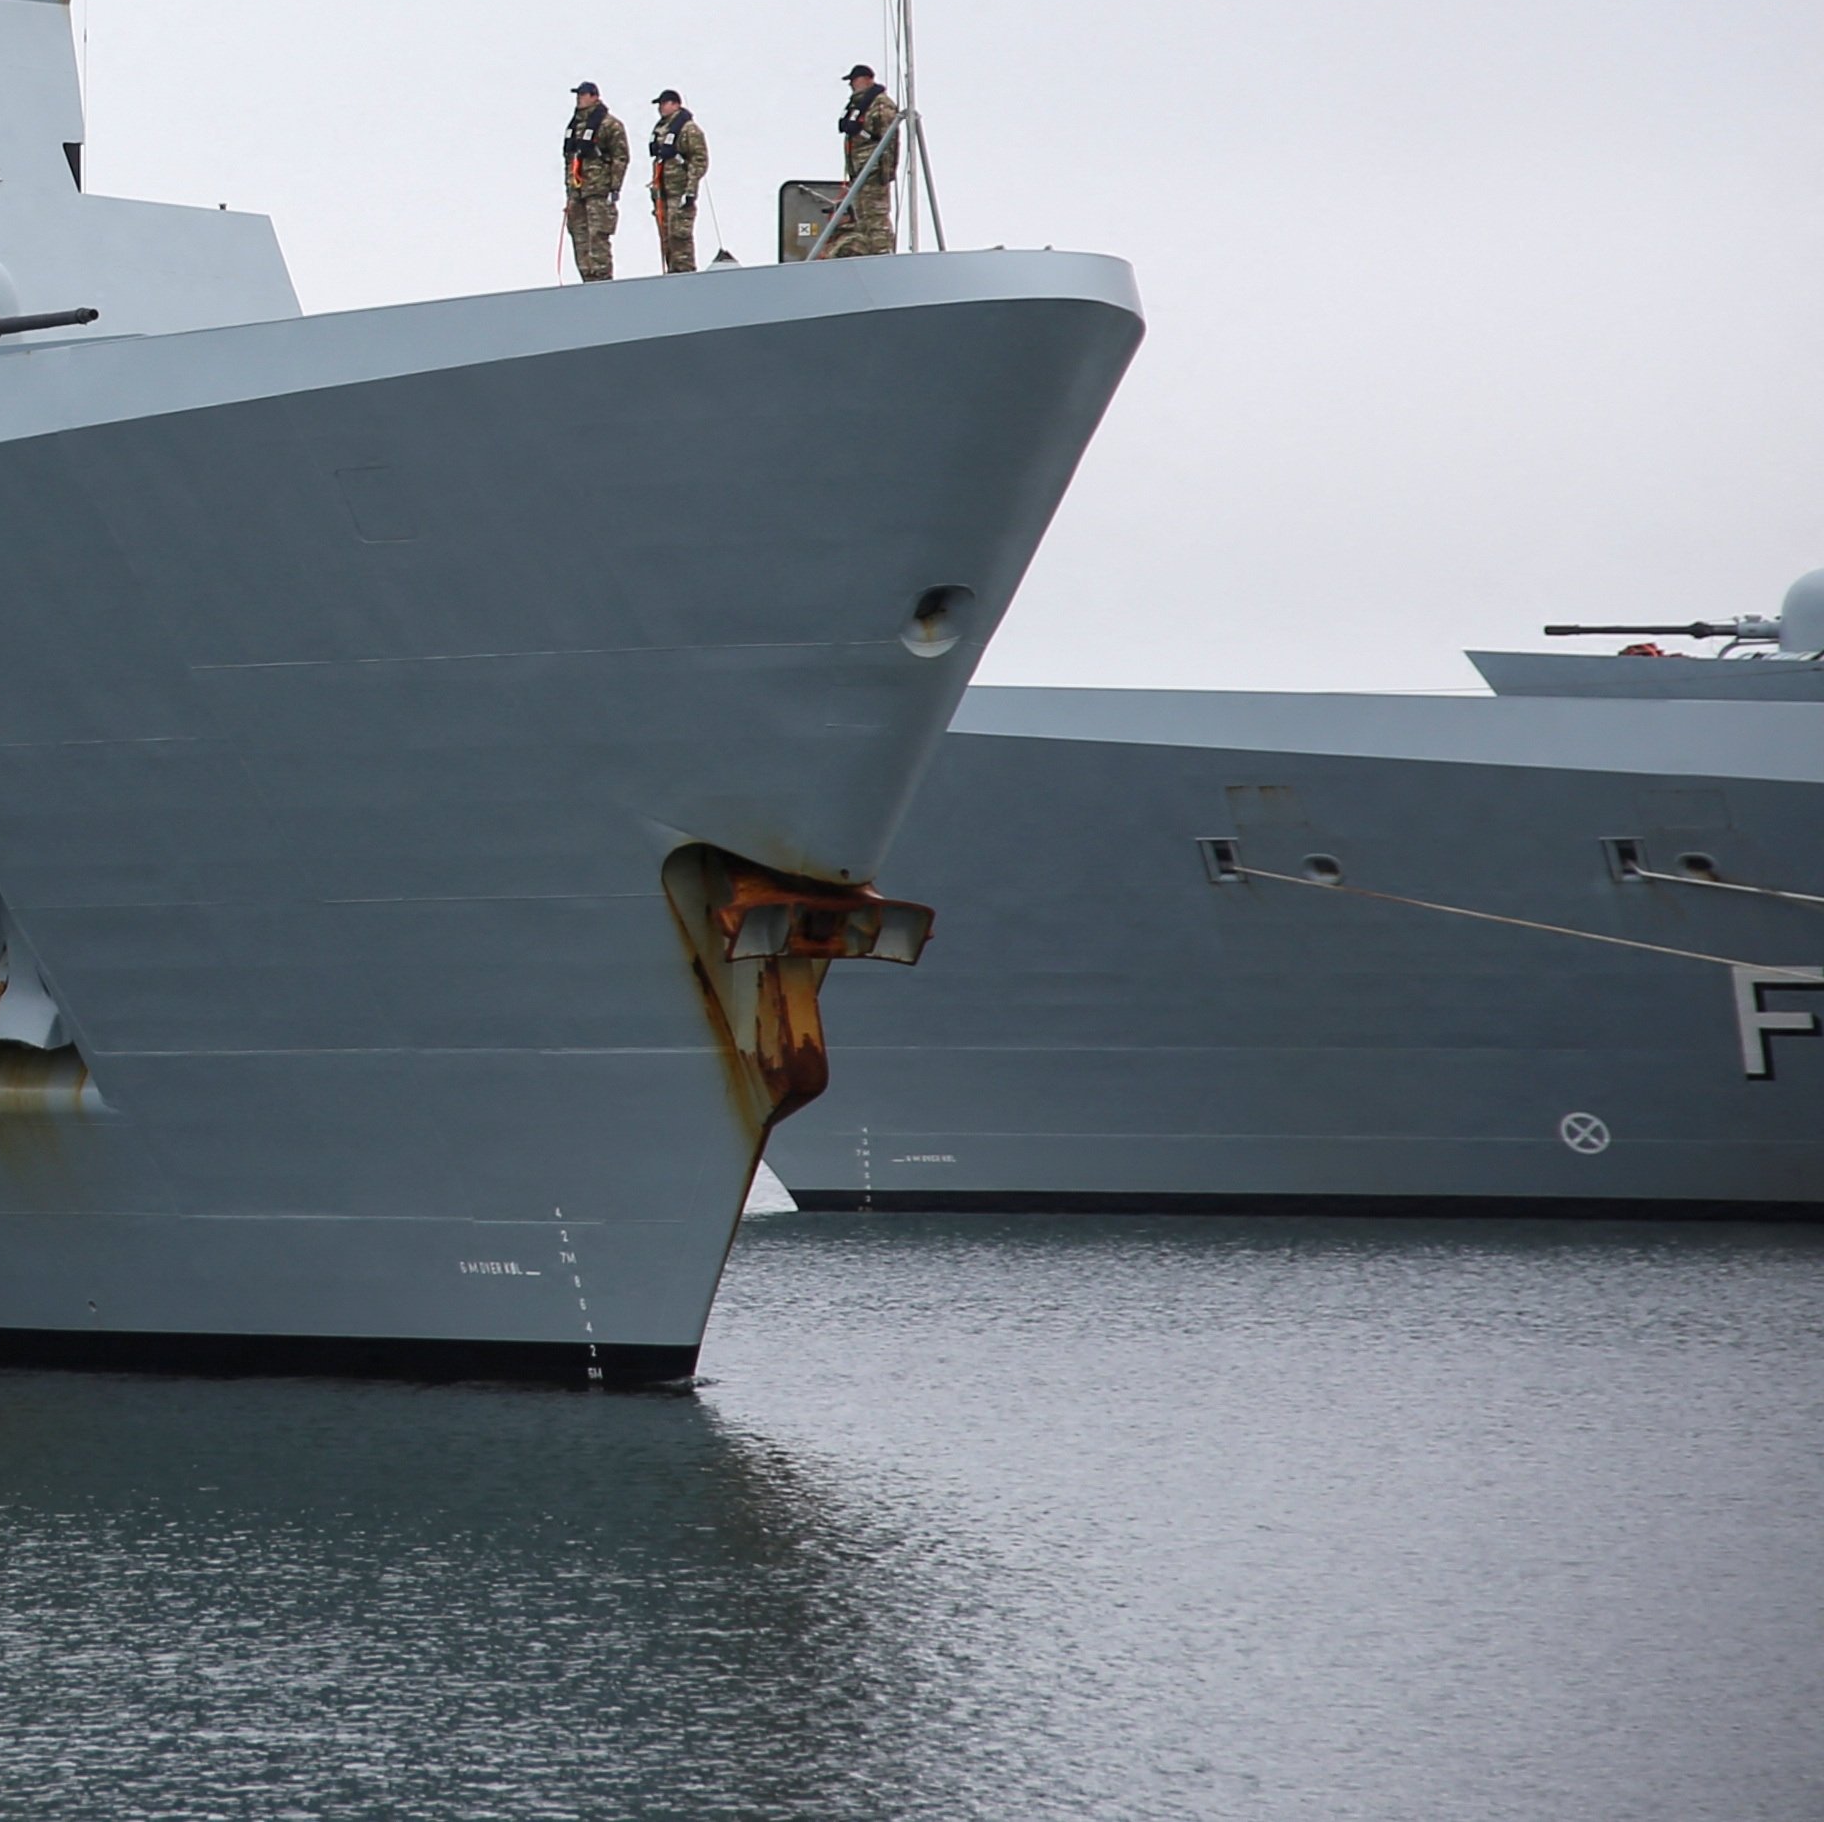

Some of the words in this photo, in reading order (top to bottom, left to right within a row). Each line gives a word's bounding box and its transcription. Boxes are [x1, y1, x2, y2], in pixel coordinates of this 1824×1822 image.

[1732, 964, 1824, 1076] F
[560, 1229, 569, 1243] 2
[559, 1251, 577, 1264] 7M
[586, 1321, 593, 1333] 4
[589, 1344, 597, 1357] 2
